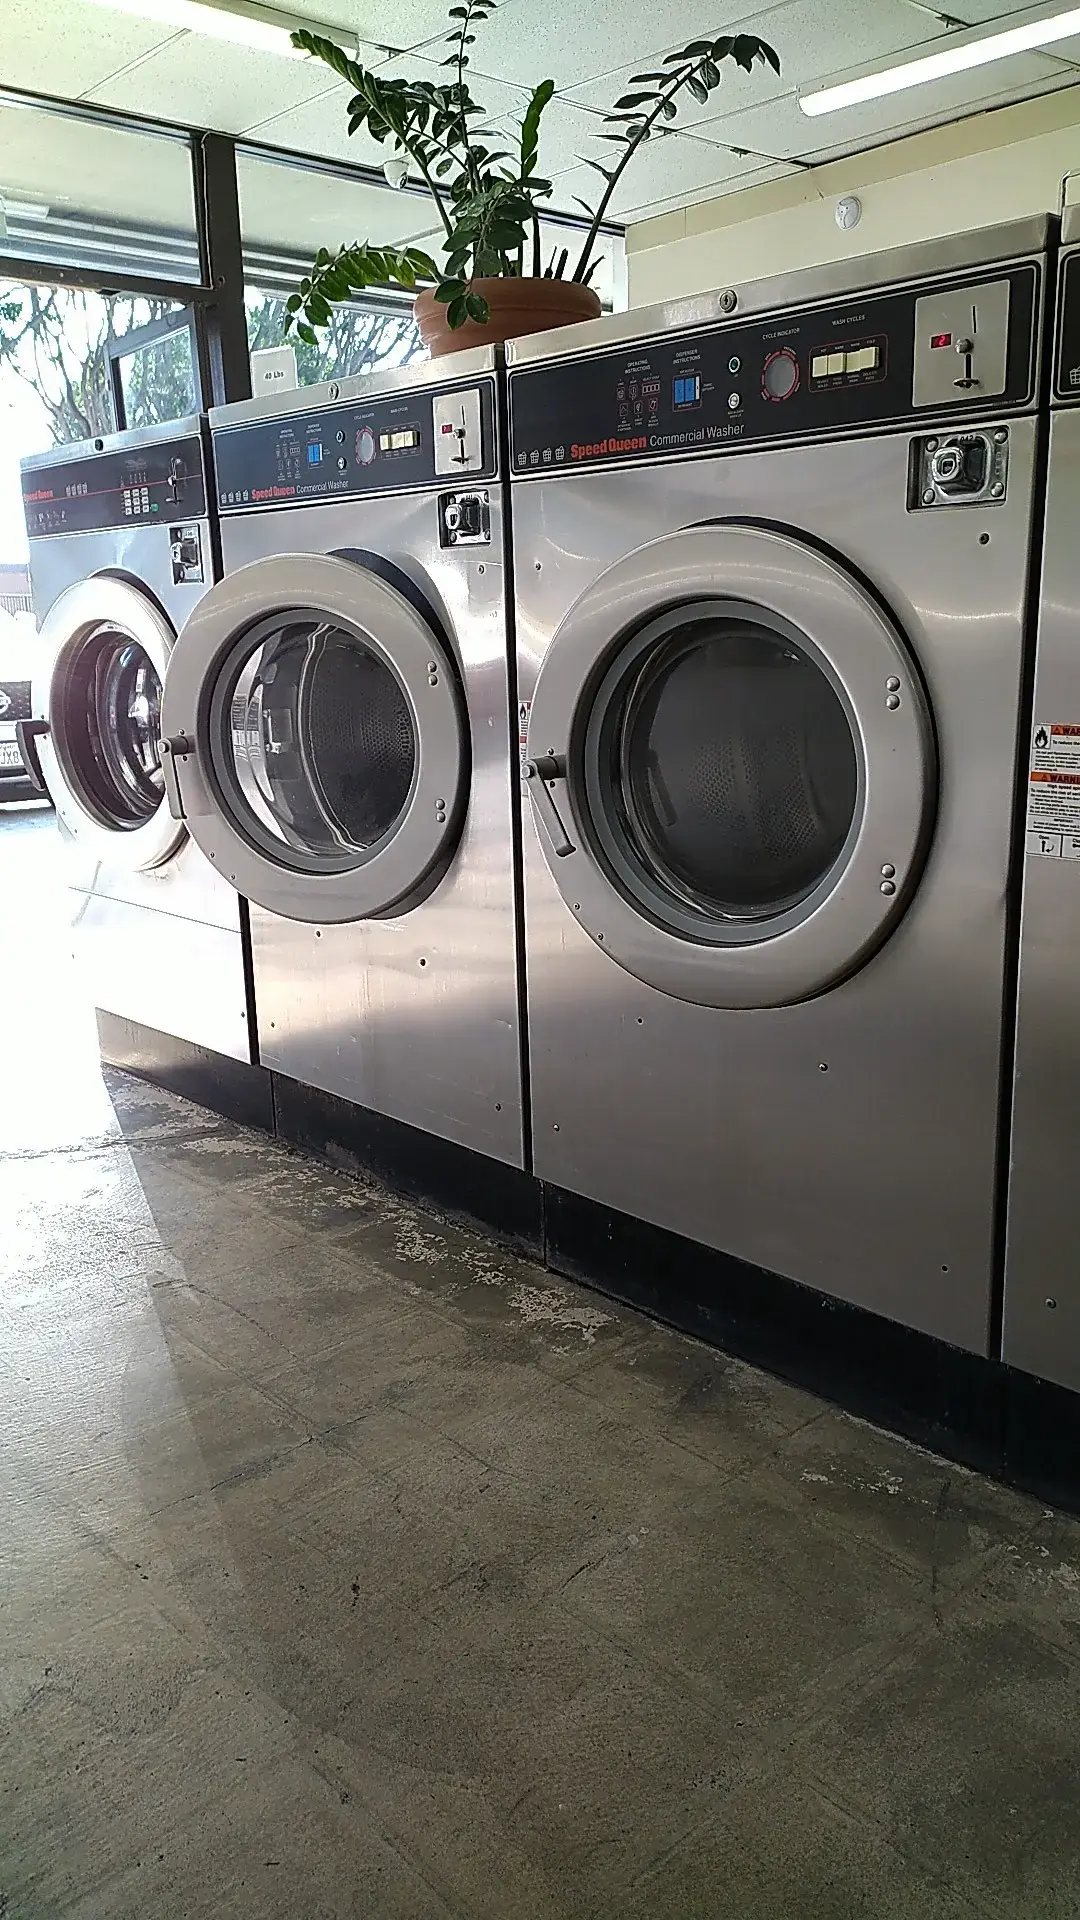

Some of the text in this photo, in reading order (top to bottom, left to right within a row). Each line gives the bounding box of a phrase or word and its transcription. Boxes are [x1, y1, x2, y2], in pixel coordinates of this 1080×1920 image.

[831, 314, 866, 326] WASH CYCLES
[762, 327, 801, 340] CYCLE INDICATOR
[673, 354, 701, 365] INSTRUCTIONS
[624, 364, 651, 374] INSTRUCTIONS
[570, 424, 745, 459] Speed Queen Commercial Washer
[251, 480, 349, 500] Speed Queen Commercial Washer
